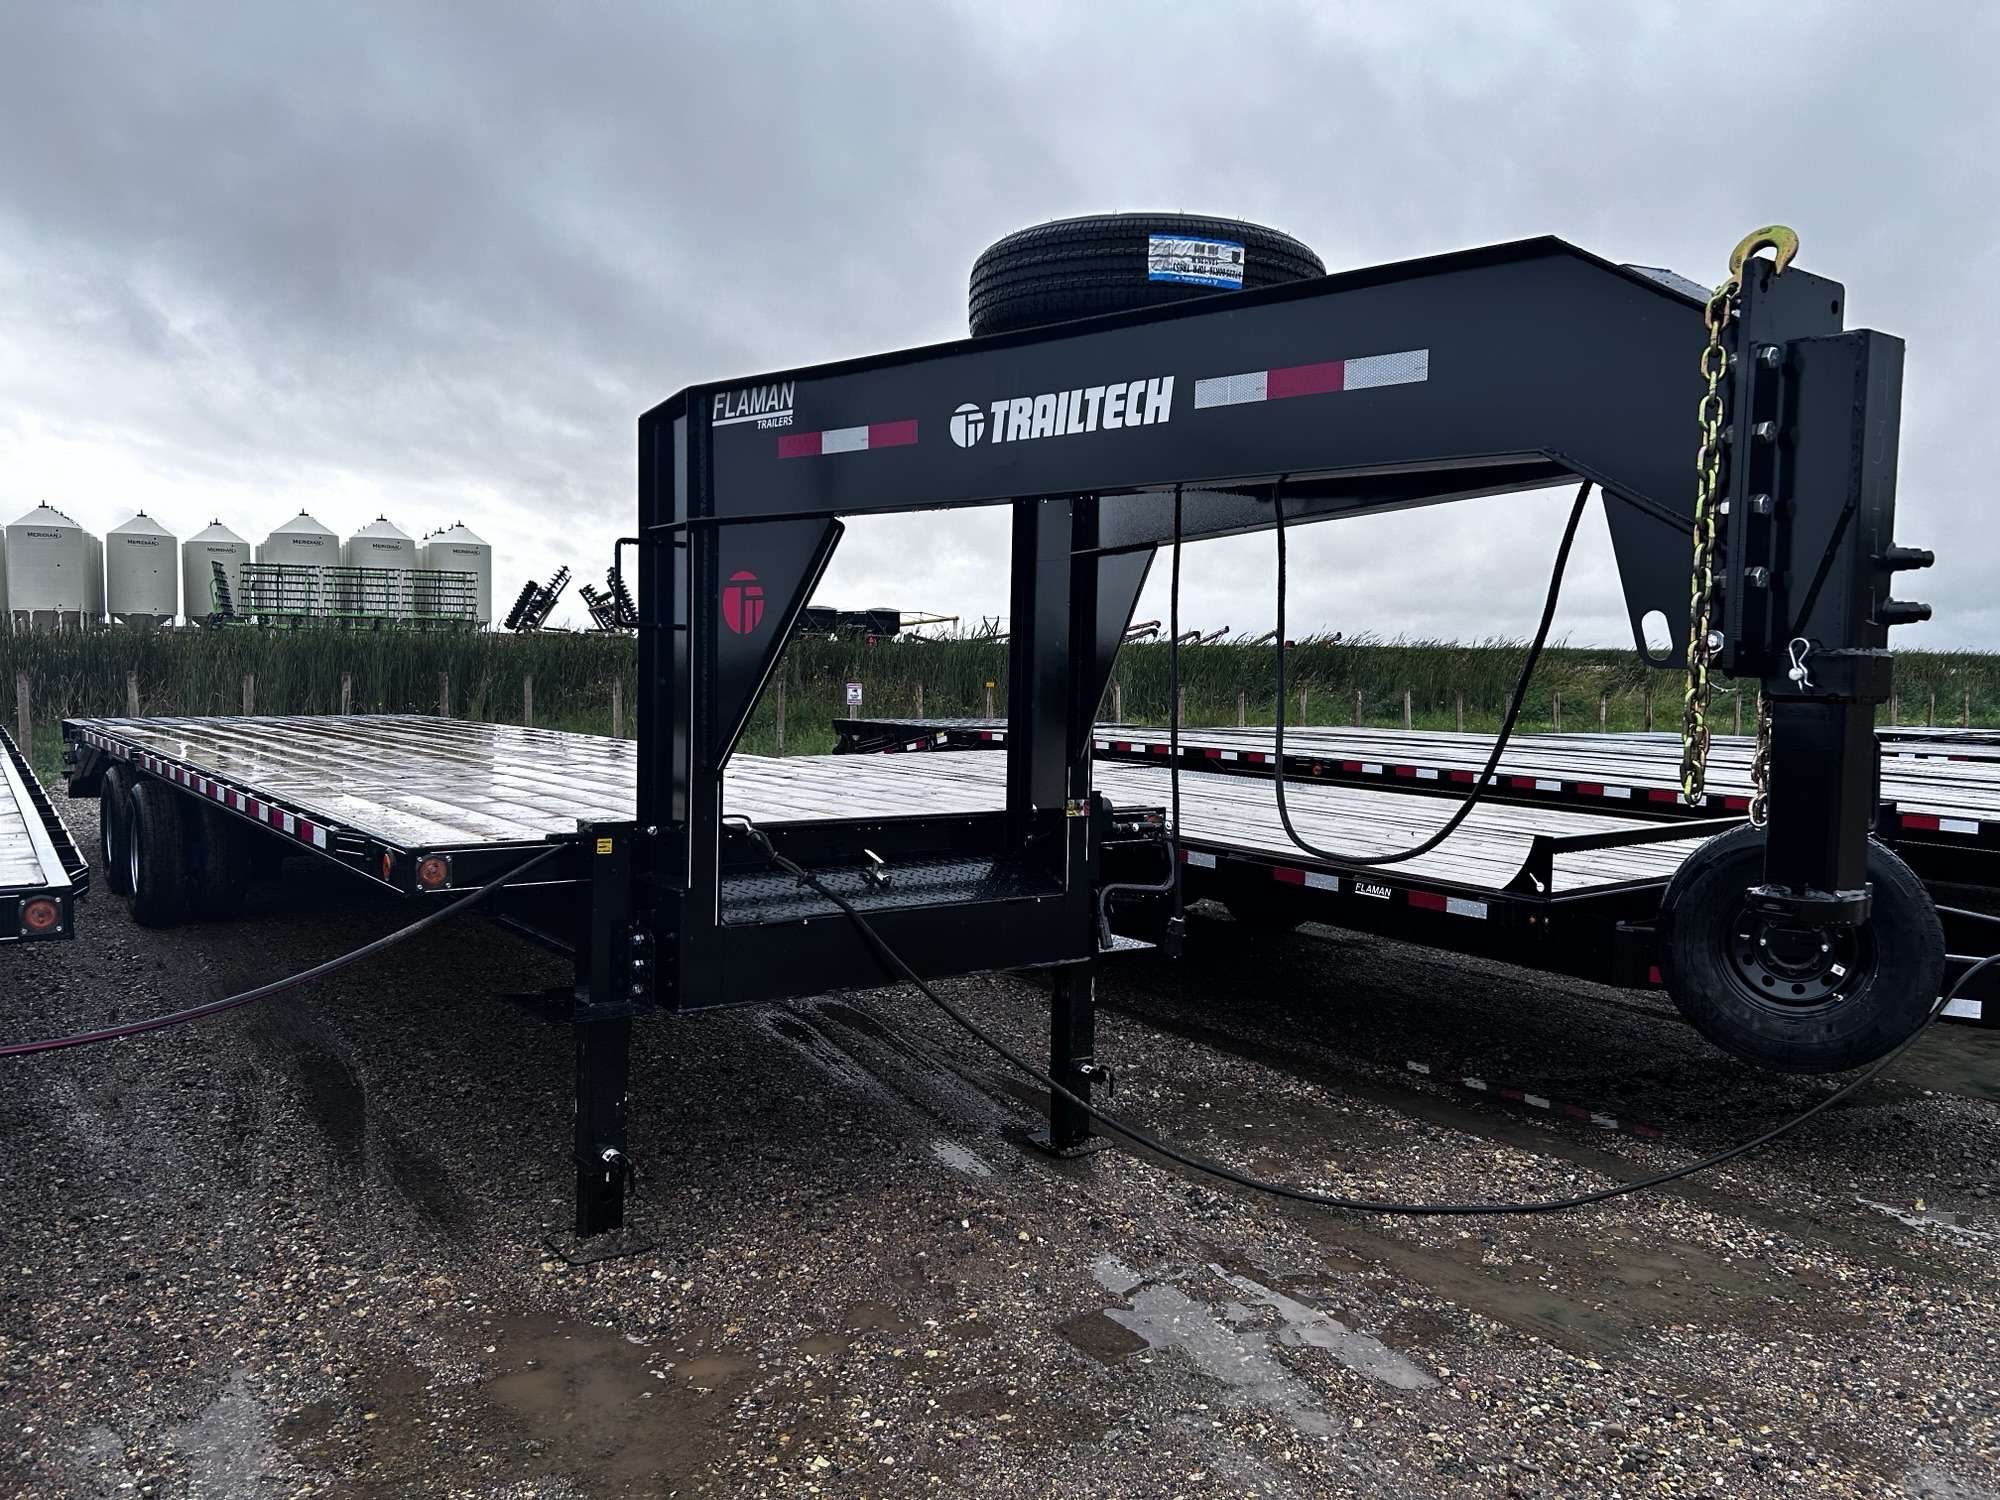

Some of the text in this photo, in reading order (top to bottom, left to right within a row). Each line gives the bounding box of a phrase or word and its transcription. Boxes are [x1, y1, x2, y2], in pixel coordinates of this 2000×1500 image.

[712, 380, 796, 421] FLAMAN
[991, 376, 1175, 444] TRAILTECH
[757, 416, 794, 430] TRAILERS
[1355, 882, 1392, 897] FLAMAN
